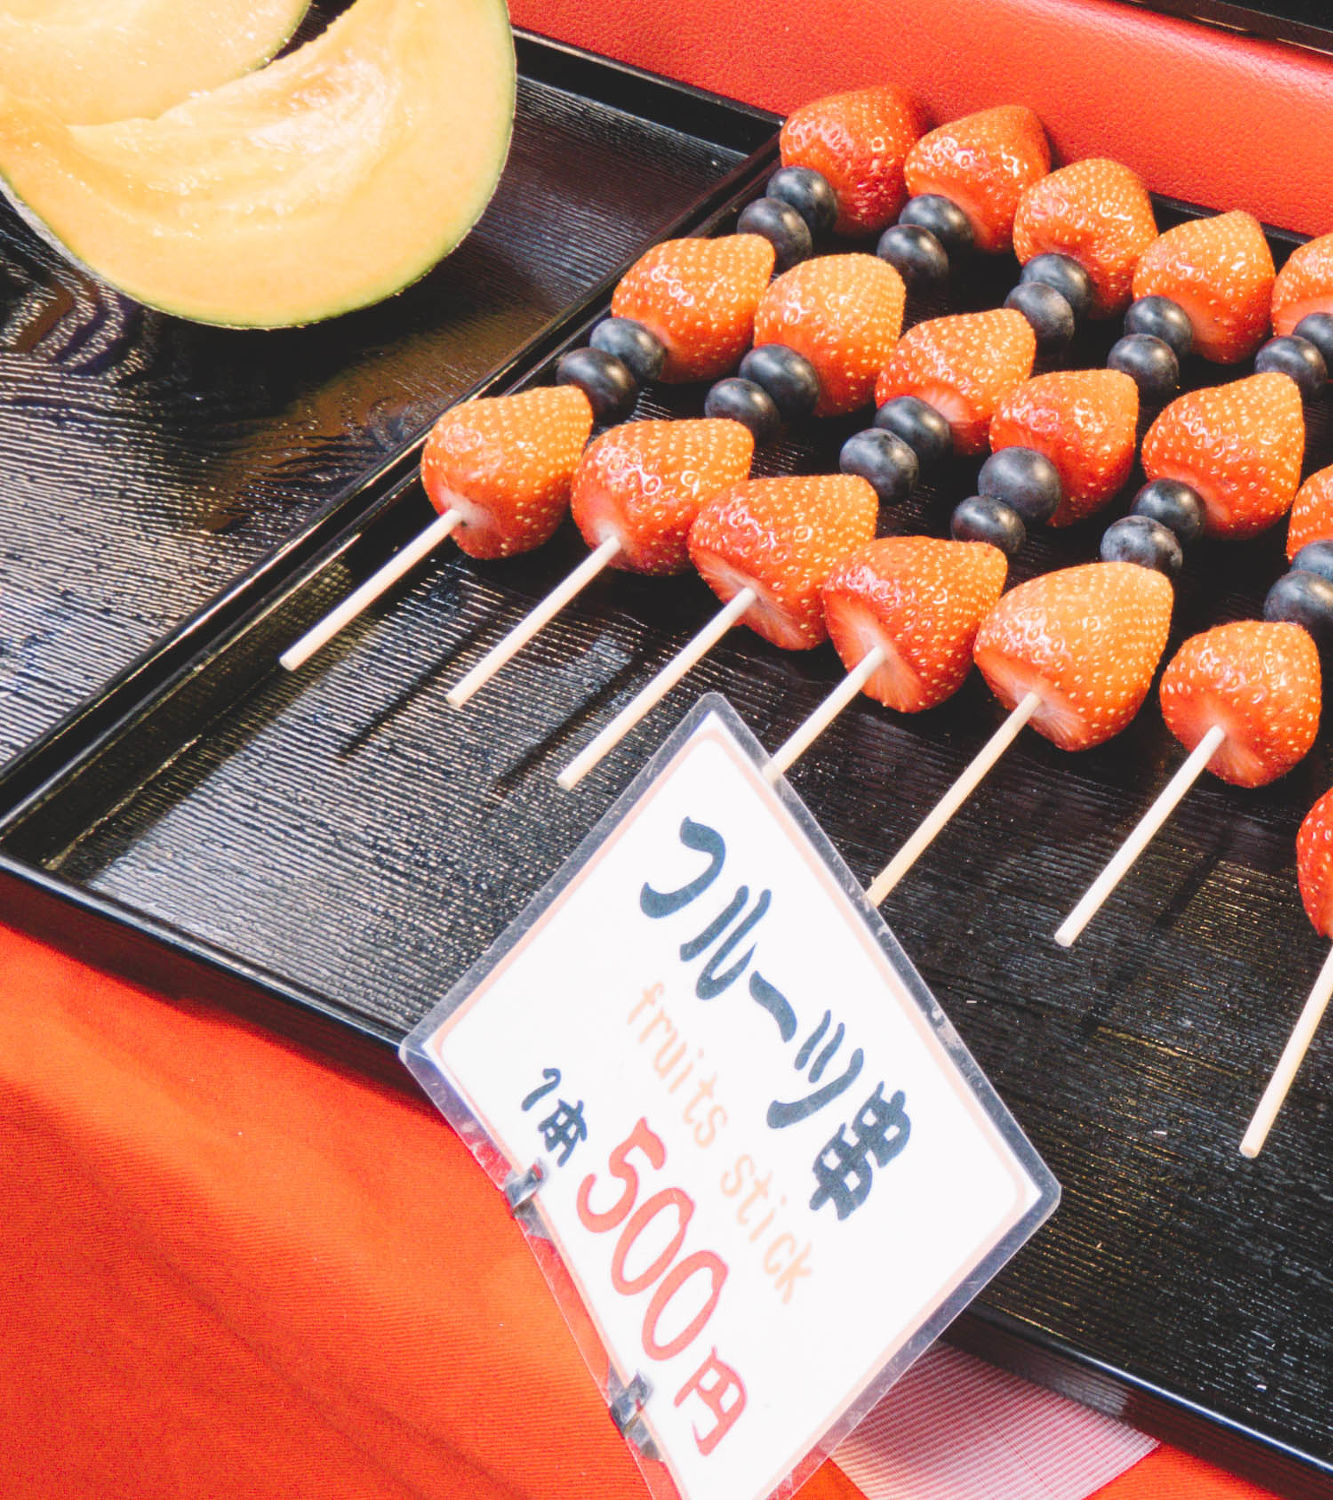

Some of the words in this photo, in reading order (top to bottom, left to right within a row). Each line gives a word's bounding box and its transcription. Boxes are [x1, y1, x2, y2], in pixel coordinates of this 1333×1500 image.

[628, 982, 728, 1150] fruits
[720, 1152, 815, 1305] stick
[639, 816, 911, 1221] フルーツ串
[575, 1117, 748, 1456] 500円
